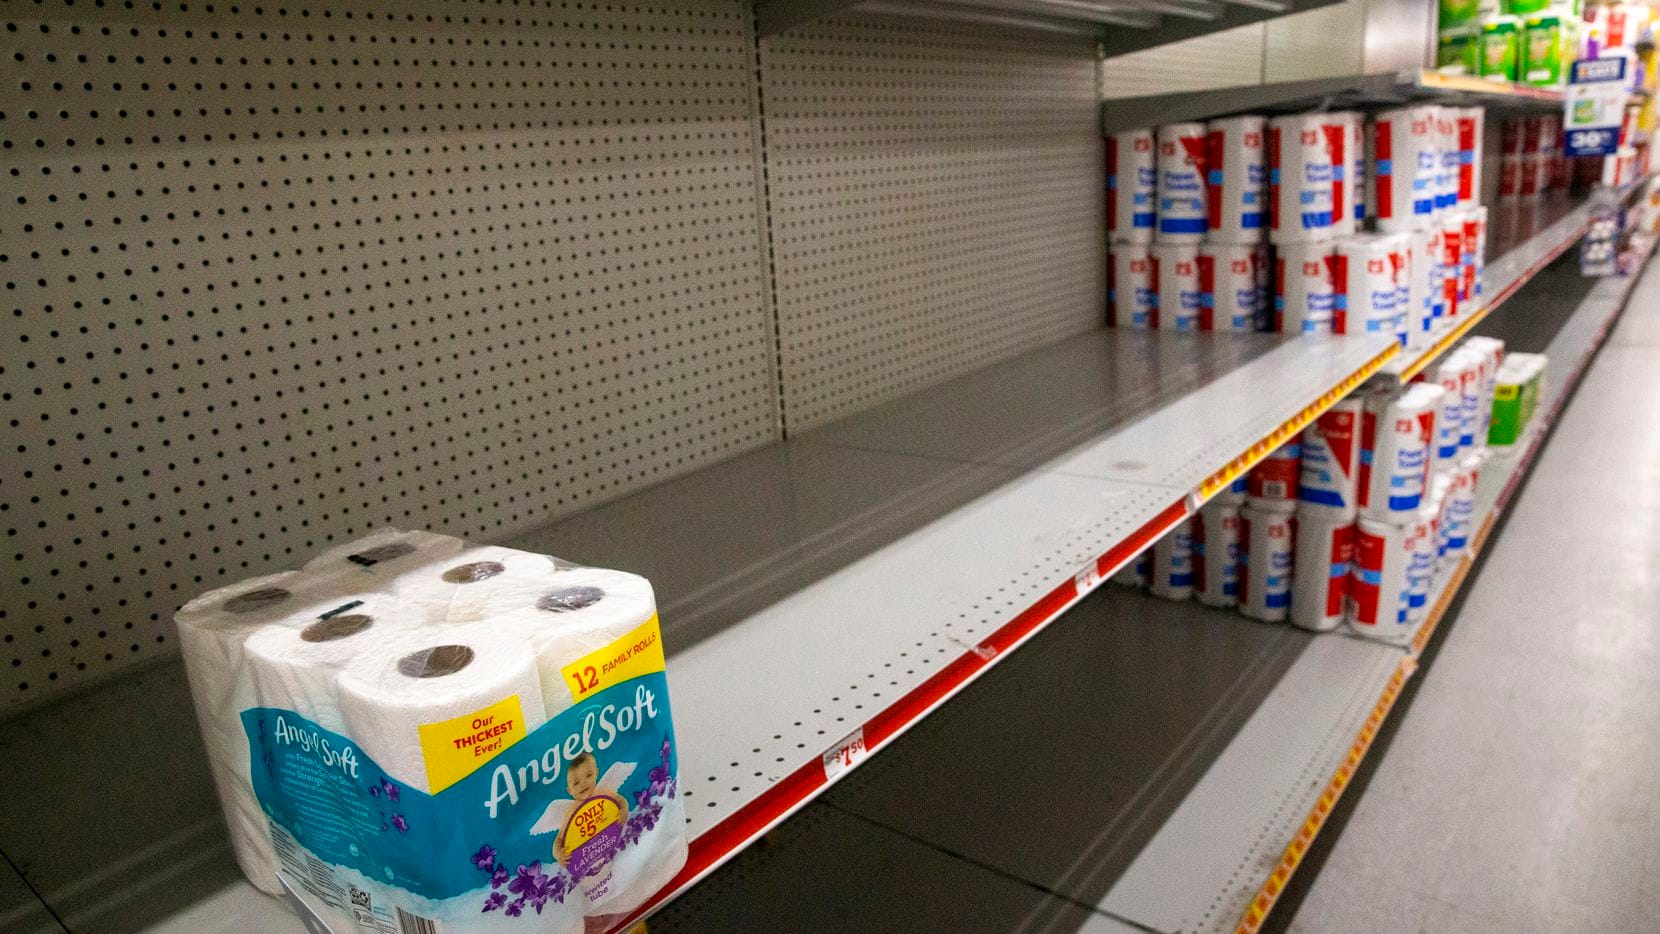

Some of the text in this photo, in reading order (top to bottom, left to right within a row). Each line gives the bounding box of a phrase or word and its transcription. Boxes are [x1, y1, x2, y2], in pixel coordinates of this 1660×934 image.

[572, 631, 657, 695] 12 FAMILY ROLLS
[453, 720, 514, 750] THICKEST
[471, 714, 495, 731] Our
[274, 715, 359, 779] Angel Soft
[474, 737, 503, 757] Ever!
[484, 684, 658, 819] Angel Soft
[574, 799, 605, 827] ONLY
[574, 836, 617, 872] LAVENDER
[581, 834, 609, 857] Fresh
[584, 871, 613, 898] scented
[590, 887, 609, 902] tube
